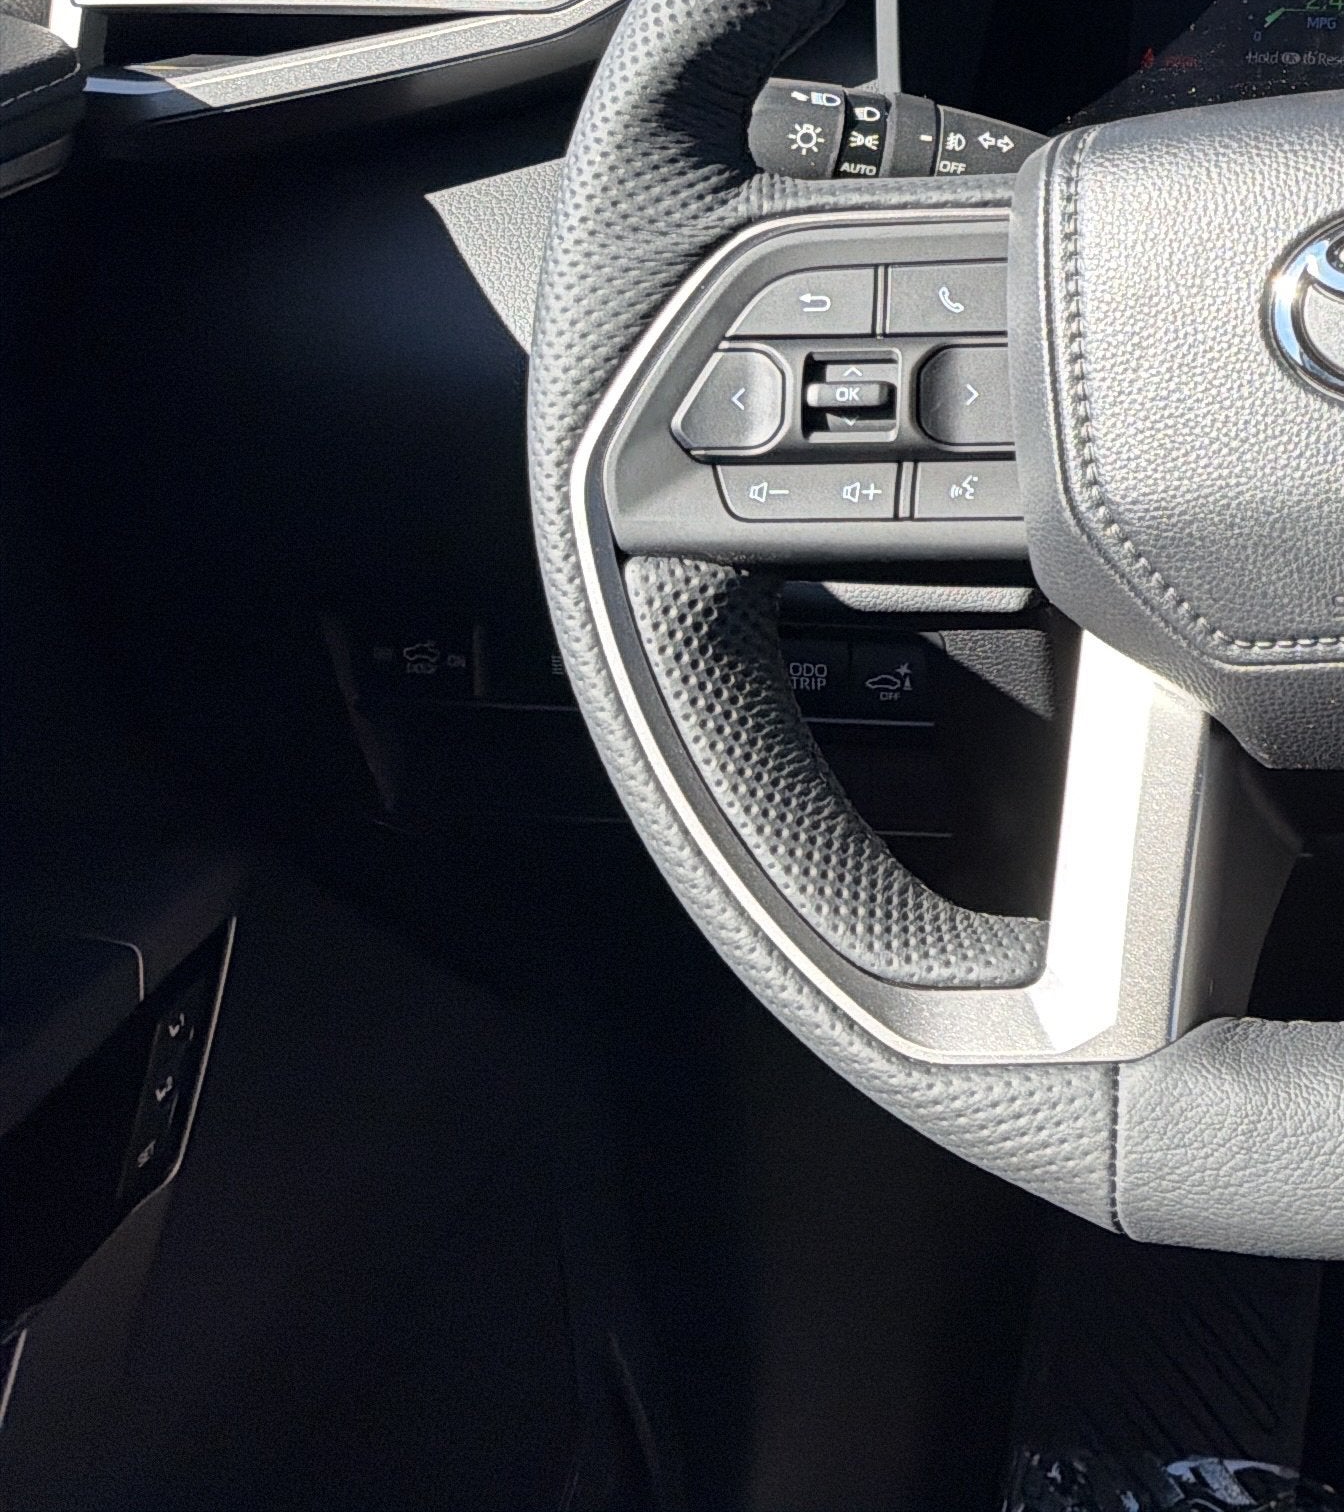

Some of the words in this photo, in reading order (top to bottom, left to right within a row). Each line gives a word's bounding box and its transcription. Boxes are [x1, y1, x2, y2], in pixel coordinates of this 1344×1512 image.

[1306, 16, 1337, 30] MPG
[1247, 50, 1279, 65] Hold
[841, 160, 877, 176] AUTO
[939, 160, 966, 175] OFF
[835, 386, 861, 402] OK
[789, 662, 828, 678] ODO
[790, 677, 827, 691] TRIP
